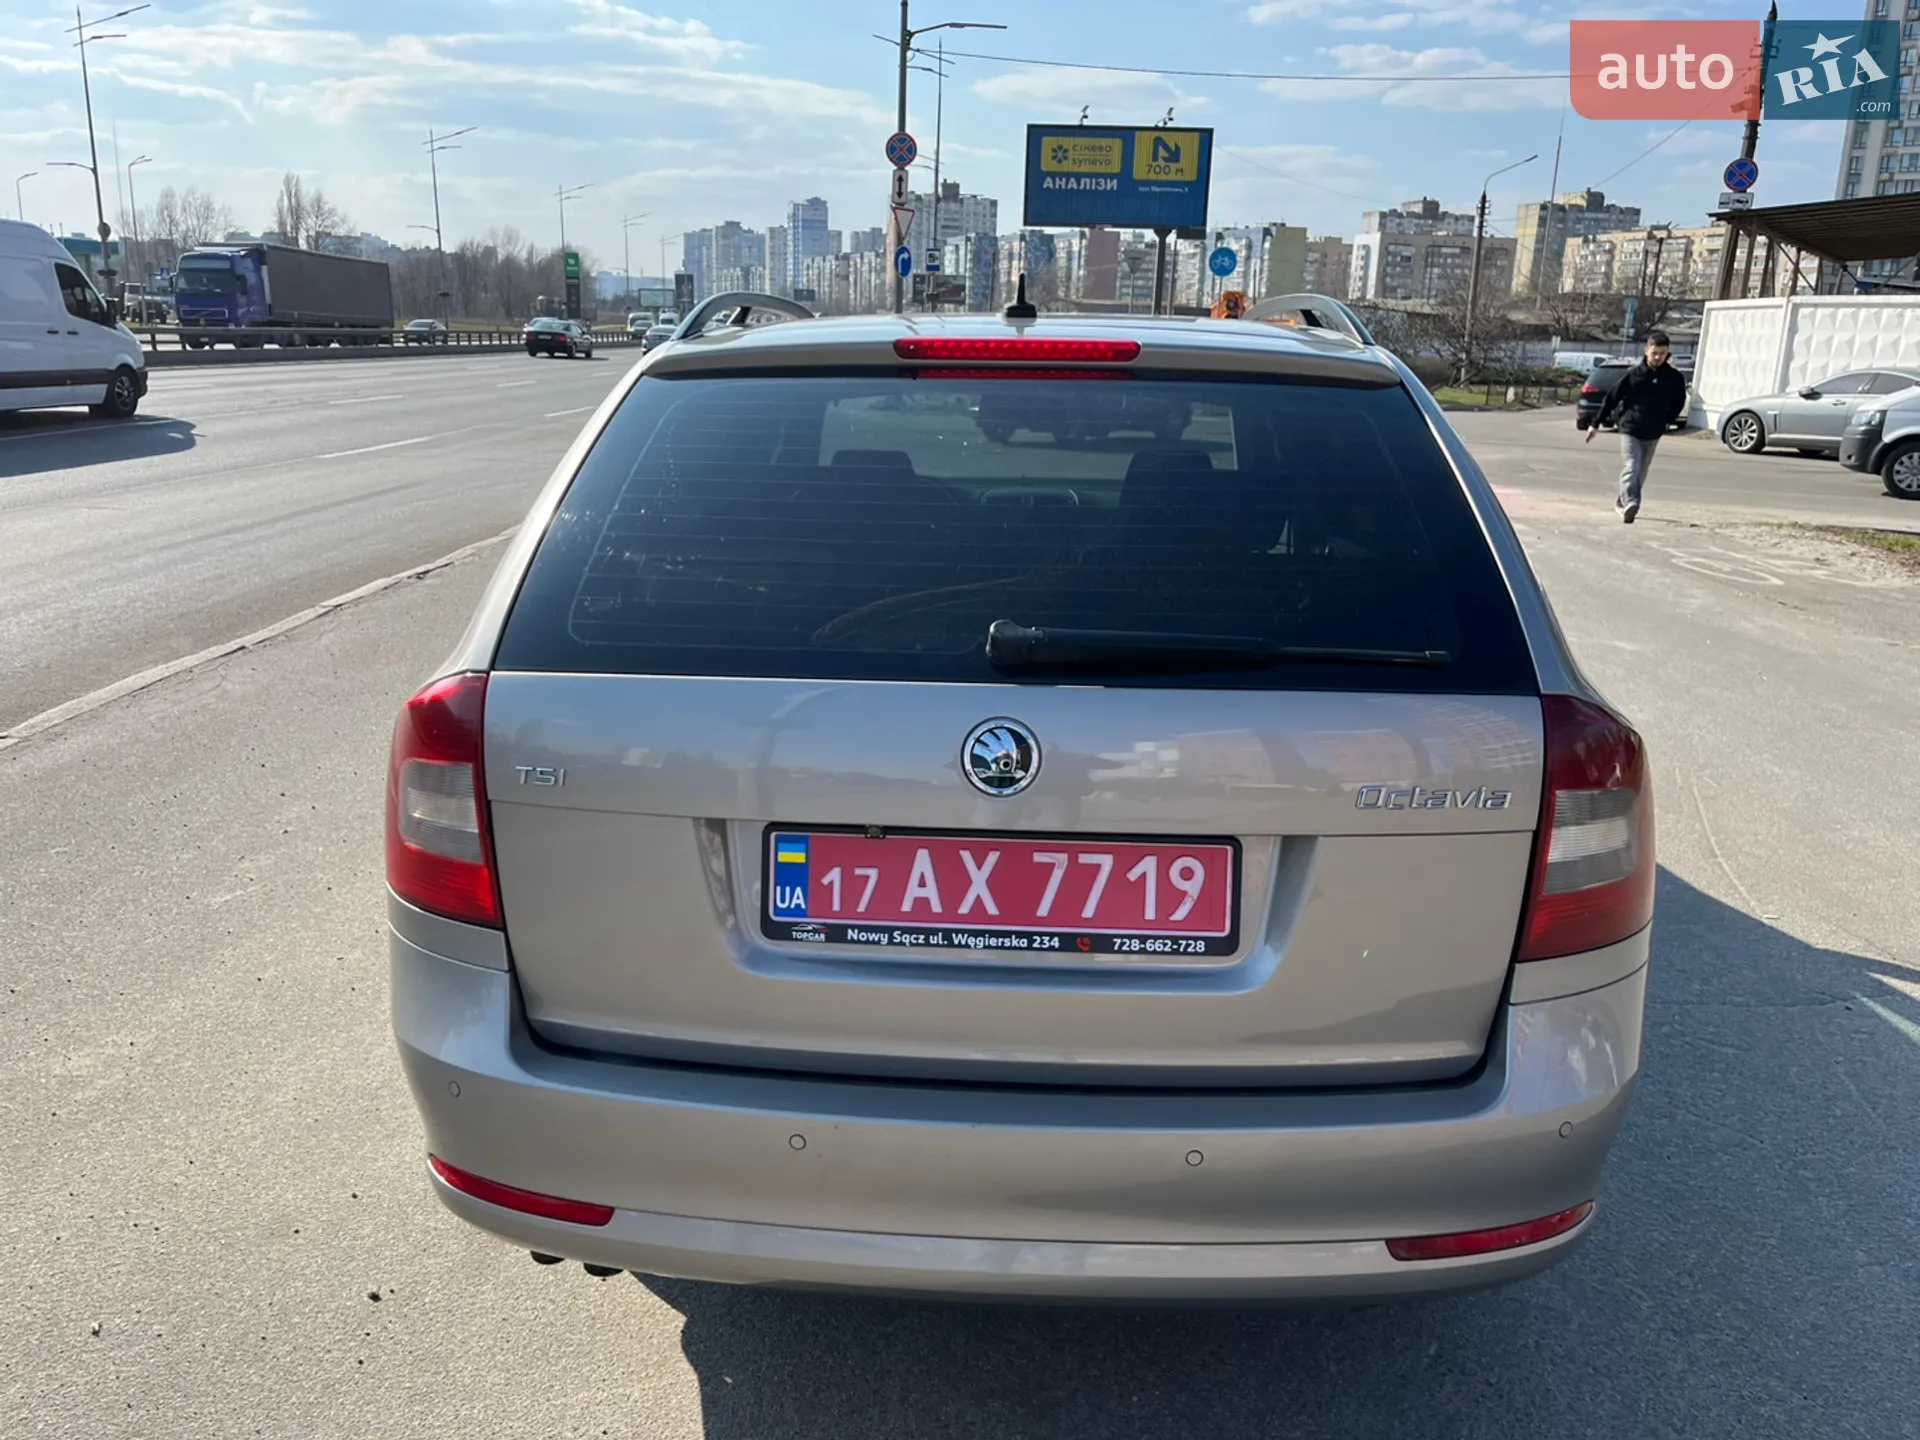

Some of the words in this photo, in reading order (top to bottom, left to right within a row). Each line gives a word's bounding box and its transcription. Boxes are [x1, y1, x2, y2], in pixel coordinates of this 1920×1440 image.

[1072, 158, 1111, 168] synevo
[1146, 164, 1171, 175] 700
[1043, 176, 1118, 191] АНАЛІЗИ
[515, 765, 566, 788] TSI
[1355, 784, 1512, 810] Octavia
[821, 866, 879, 913] 17
[901, 848, 1000, 916] AX
[1032, 852, 1206, 921] 7719
[776, 885, 806, 910] UA
[847, 928, 888, 945] Nowy
[893, 931, 925, 946] Sącz
[929, 932, 948, 945] ul.
[952, 933, 1028, 949] Węgierska
[1032, 935, 1060, 948] 234
[1112, 938, 1205, 953] 728-662-728
